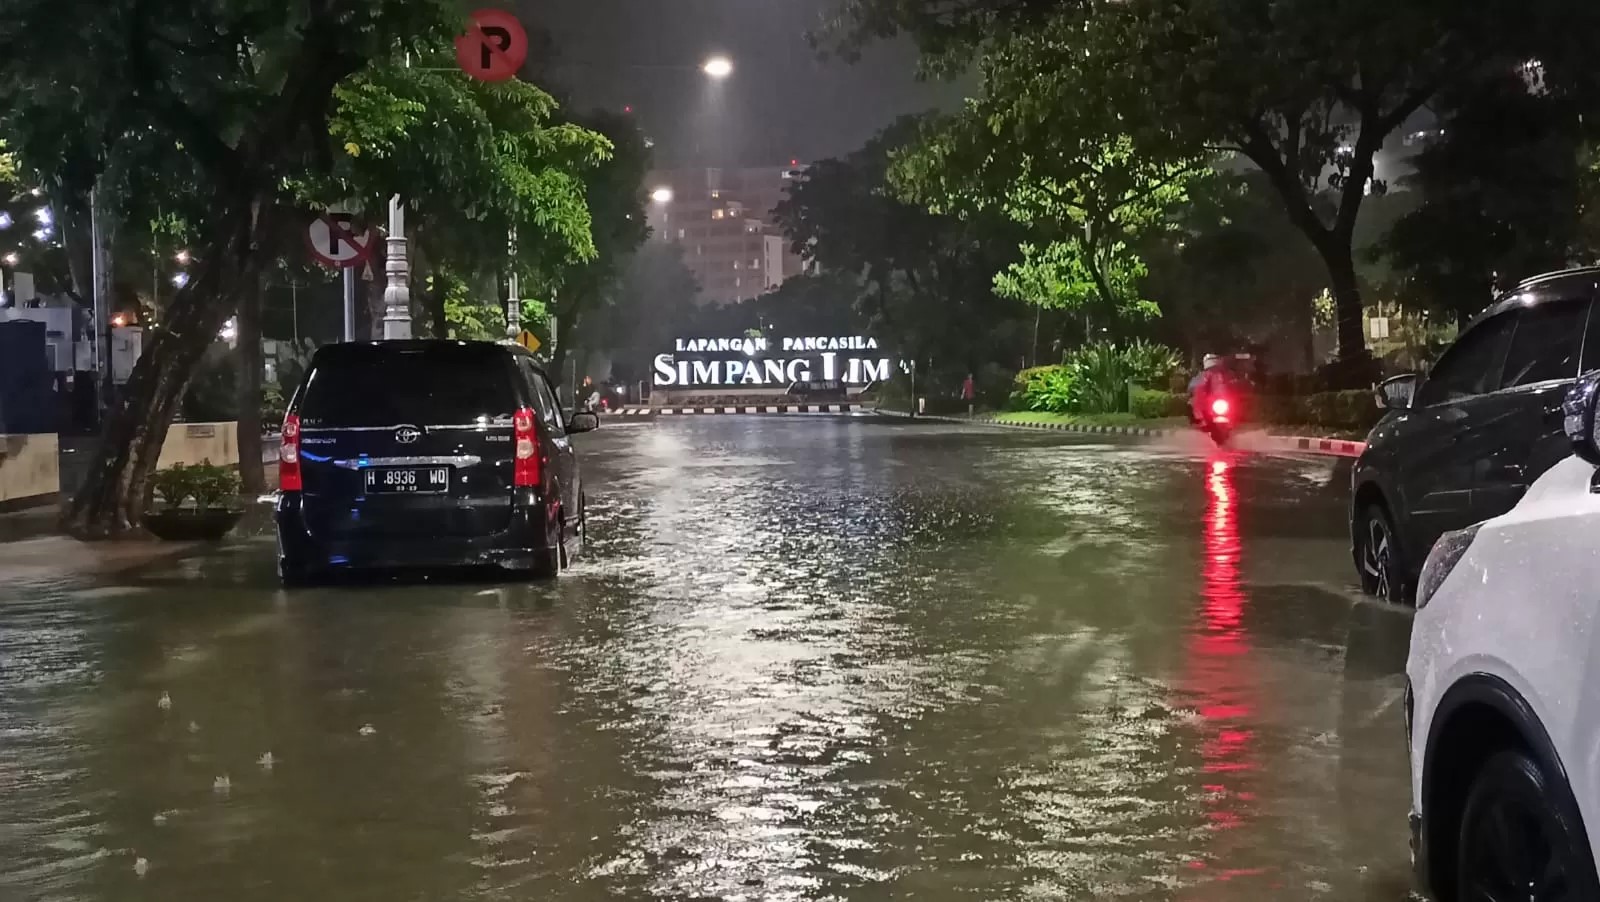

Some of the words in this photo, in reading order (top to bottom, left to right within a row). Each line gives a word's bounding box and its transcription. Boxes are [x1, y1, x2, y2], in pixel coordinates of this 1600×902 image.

[480, 26, 511, 69] P
[675, 338, 767, 352] LAPANGAN
[782, 336, 878, 350] PANCASILA
[653, 353, 810, 385] SIMPANG
[820, 352, 910, 383] LIM
[367, 471, 375, 485] H
